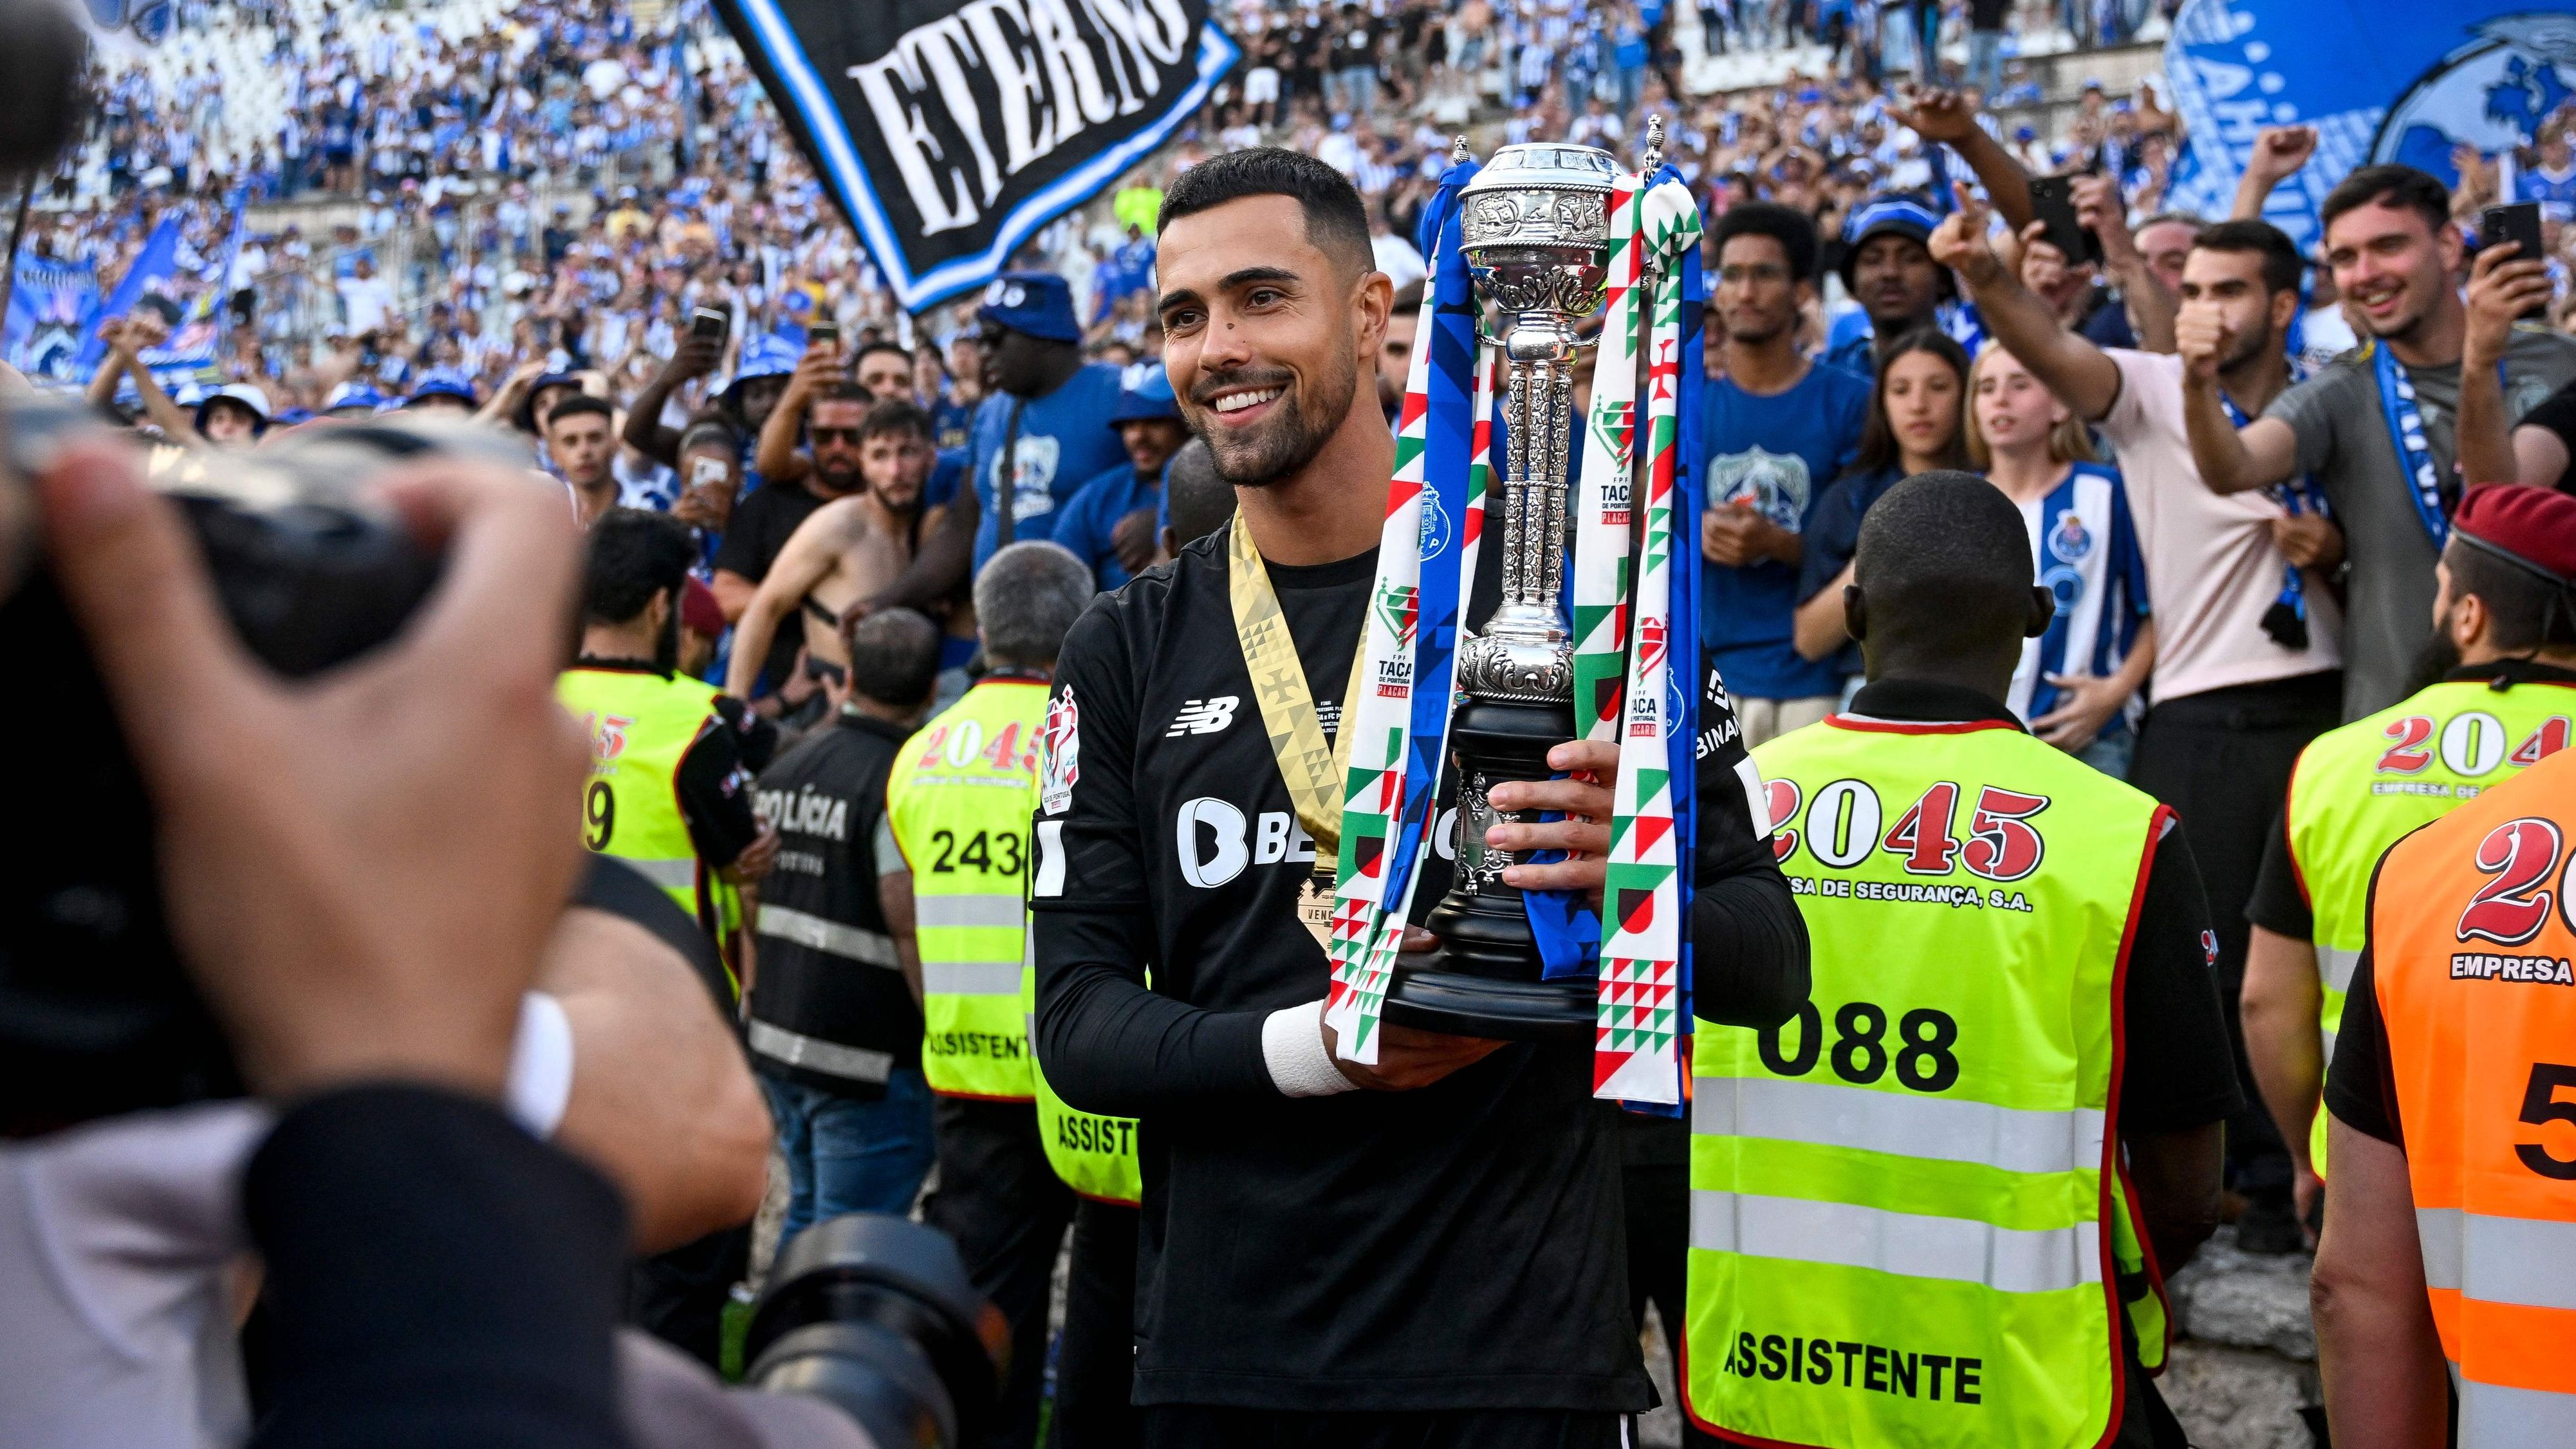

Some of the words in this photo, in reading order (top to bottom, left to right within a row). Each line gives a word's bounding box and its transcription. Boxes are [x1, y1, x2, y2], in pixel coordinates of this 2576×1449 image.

[847, 0, 1191, 237] ETERNO
[1378, 685, 1409, 697] PLACAR
[932, 829, 1022, 876] 243
[1761, 777, 2052, 883] 2045
[1822, 879, 1850, 898] DE
[1855, 881, 1984, 910] SEGURANÇA,
[1988, 890, 2034, 912] S.A.
[2450, 952, 2575, 987] EMPRESA
[1757, 1000, 1960, 1093] 088
[1059, 1114, 1140, 1155] ASSIST
[1724, 1331, 1983, 1406] ASSISTENTE
